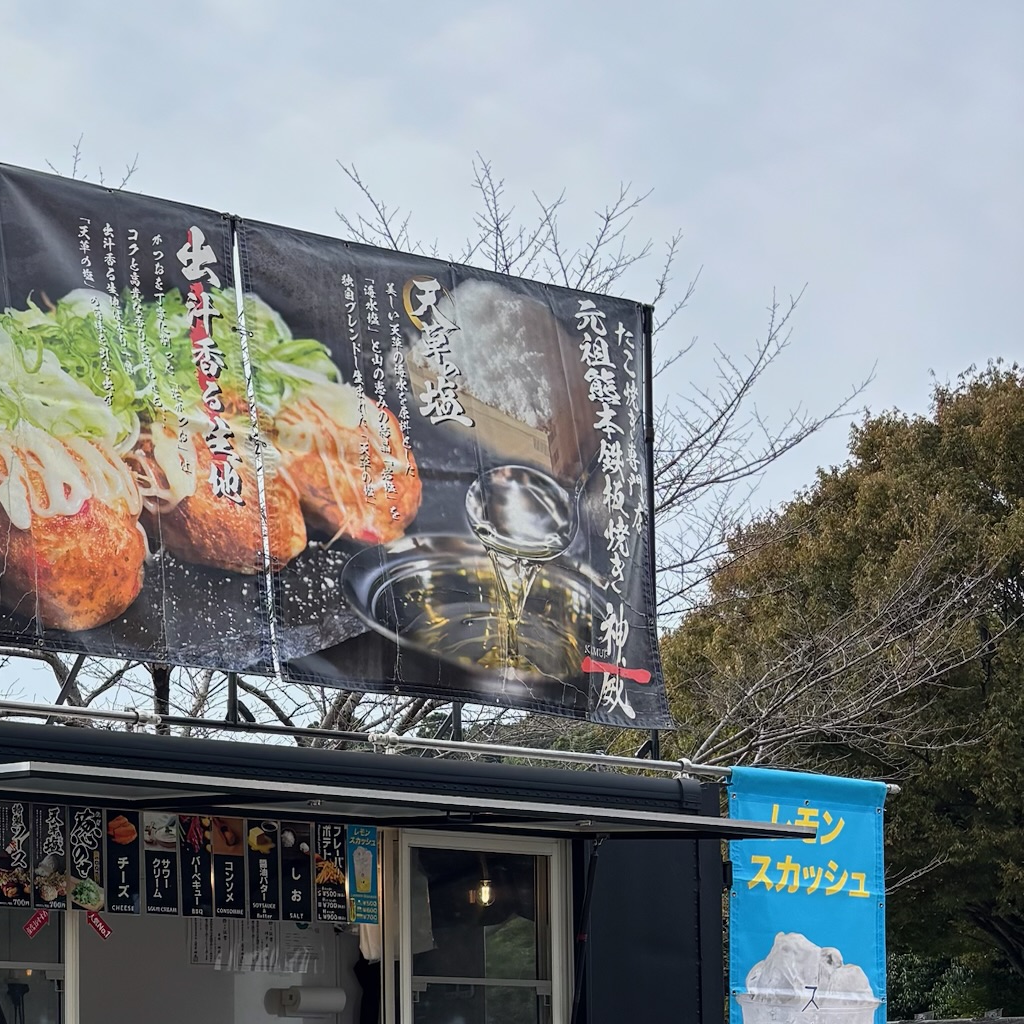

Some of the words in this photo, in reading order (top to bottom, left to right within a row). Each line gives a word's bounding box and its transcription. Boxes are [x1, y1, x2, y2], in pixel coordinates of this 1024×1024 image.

[411, 278, 476, 427] 天草の塩
[575, 299, 631, 594] 元祖熊本鉄板焼き
[322, 824, 332, 861] ポテト
[116, 855, 131, 899] チーズ
[152, 857, 163, 899] クリーム
[161, 858, 172, 889] サワー
[191, 855, 203, 905] バーベキュー
[224, 861, 234, 903] コンソメ
[290, 866, 302, 902] しお
[747, 855, 870, 898] スカッシュ
[111, 903, 135, 912] CHEESE
[191, 908, 204, 916] BBQ
